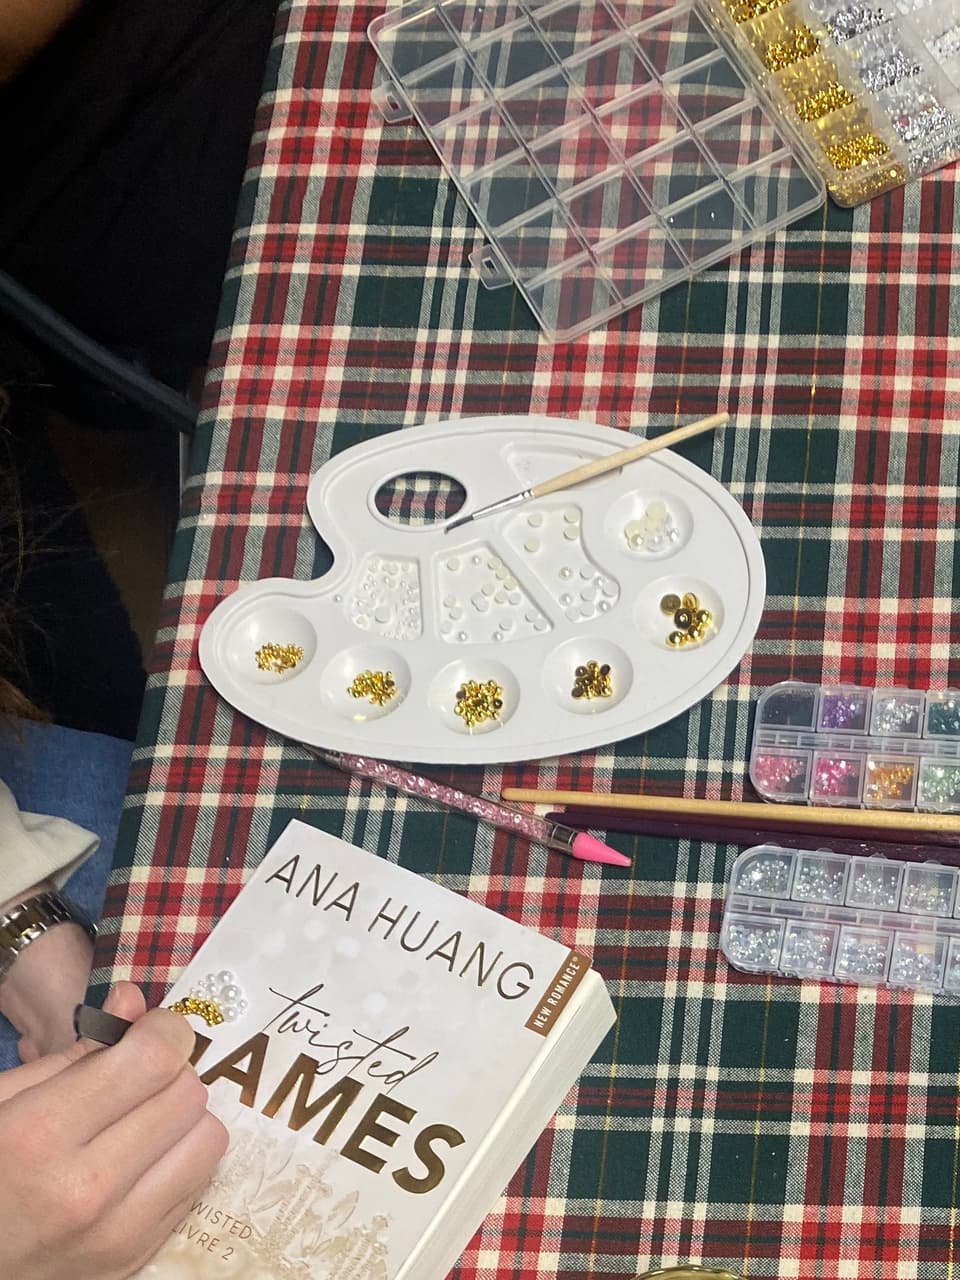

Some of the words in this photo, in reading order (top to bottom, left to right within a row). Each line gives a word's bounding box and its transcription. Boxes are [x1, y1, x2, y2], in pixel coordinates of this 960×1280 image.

[265, 854, 360, 922] ANA
[368, 897, 535, 1000] HUANG
[533, 1006, 552, 1029] NEW
[262, 983, 440, 1096] twisted
[171, 1219, 220, 1253] LIVRE
[222, 1246, 234, 1261] 2
[189, 1201, 252, 1240] WISTED
